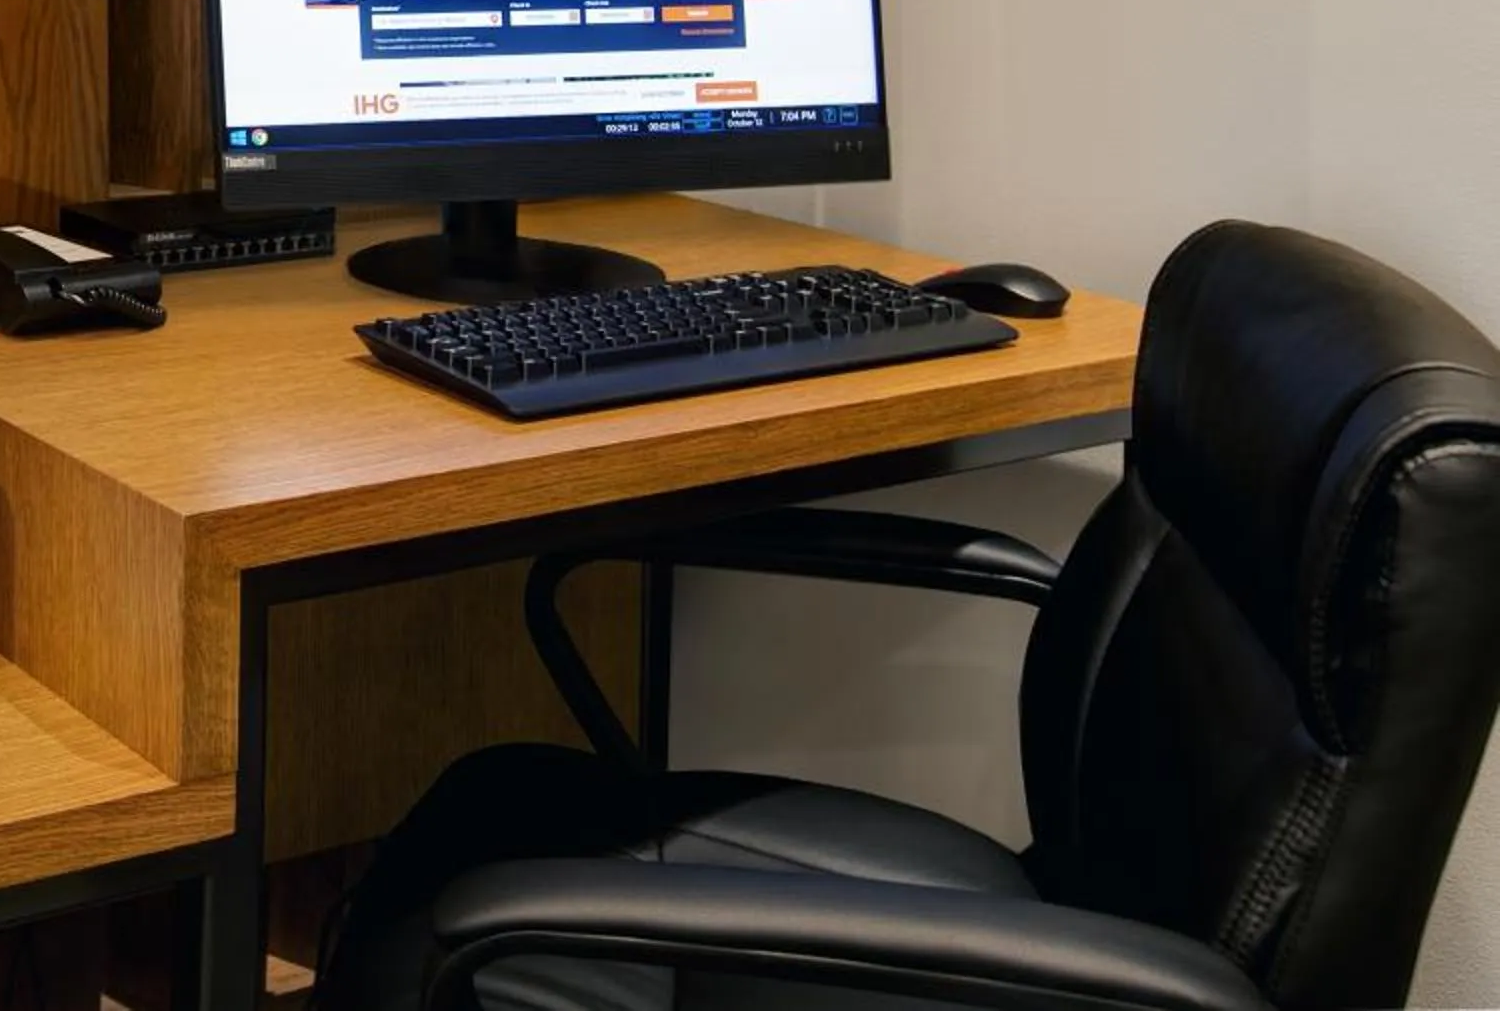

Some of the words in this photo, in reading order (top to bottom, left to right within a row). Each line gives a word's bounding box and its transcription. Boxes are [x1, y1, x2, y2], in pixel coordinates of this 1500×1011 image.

[353, 94, 399, 115] IHG
[731, 109, 759, 119] Monday
[780, 110, 799, 122] 7:04
[801, 110, 817, 121] PM
[727, 118, 754, 129] October
